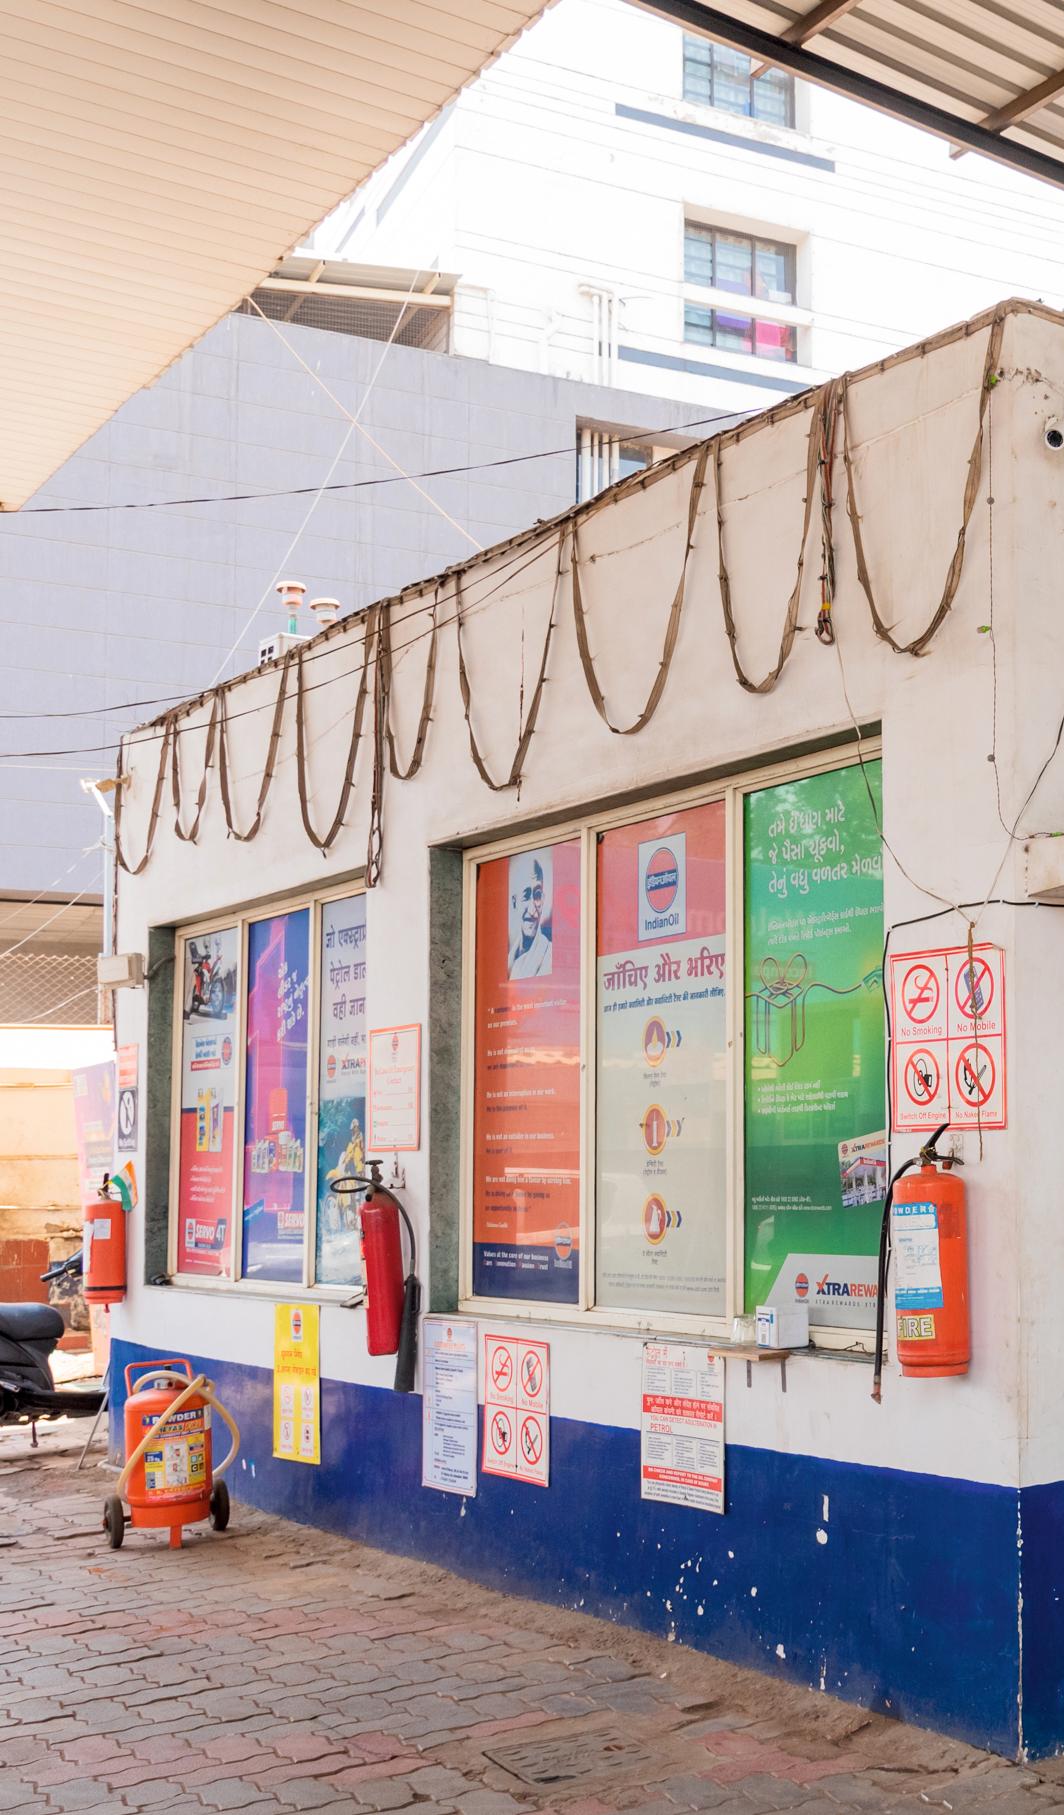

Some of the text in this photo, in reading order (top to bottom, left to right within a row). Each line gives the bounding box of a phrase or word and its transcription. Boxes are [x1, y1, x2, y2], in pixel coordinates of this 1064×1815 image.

[644, 913, 679, 931] IndianOil
[604, 947, 726, 991] जाँचिए और भरिए
[902, 1025, 942, 1037] No Smoking
[957, 1021, 996, 1032] No Mobile
[927, 1112, 946, 1121] Engine
[981, 1110, 997, 1119] Flame
[195, 1223, 227, 1240] SERVO 4T
[897, 1317, 933, 1338] FIRE
[152, 1410, 196, 1424] PWDER
[651, 1423, 672, 1434] PETROL
